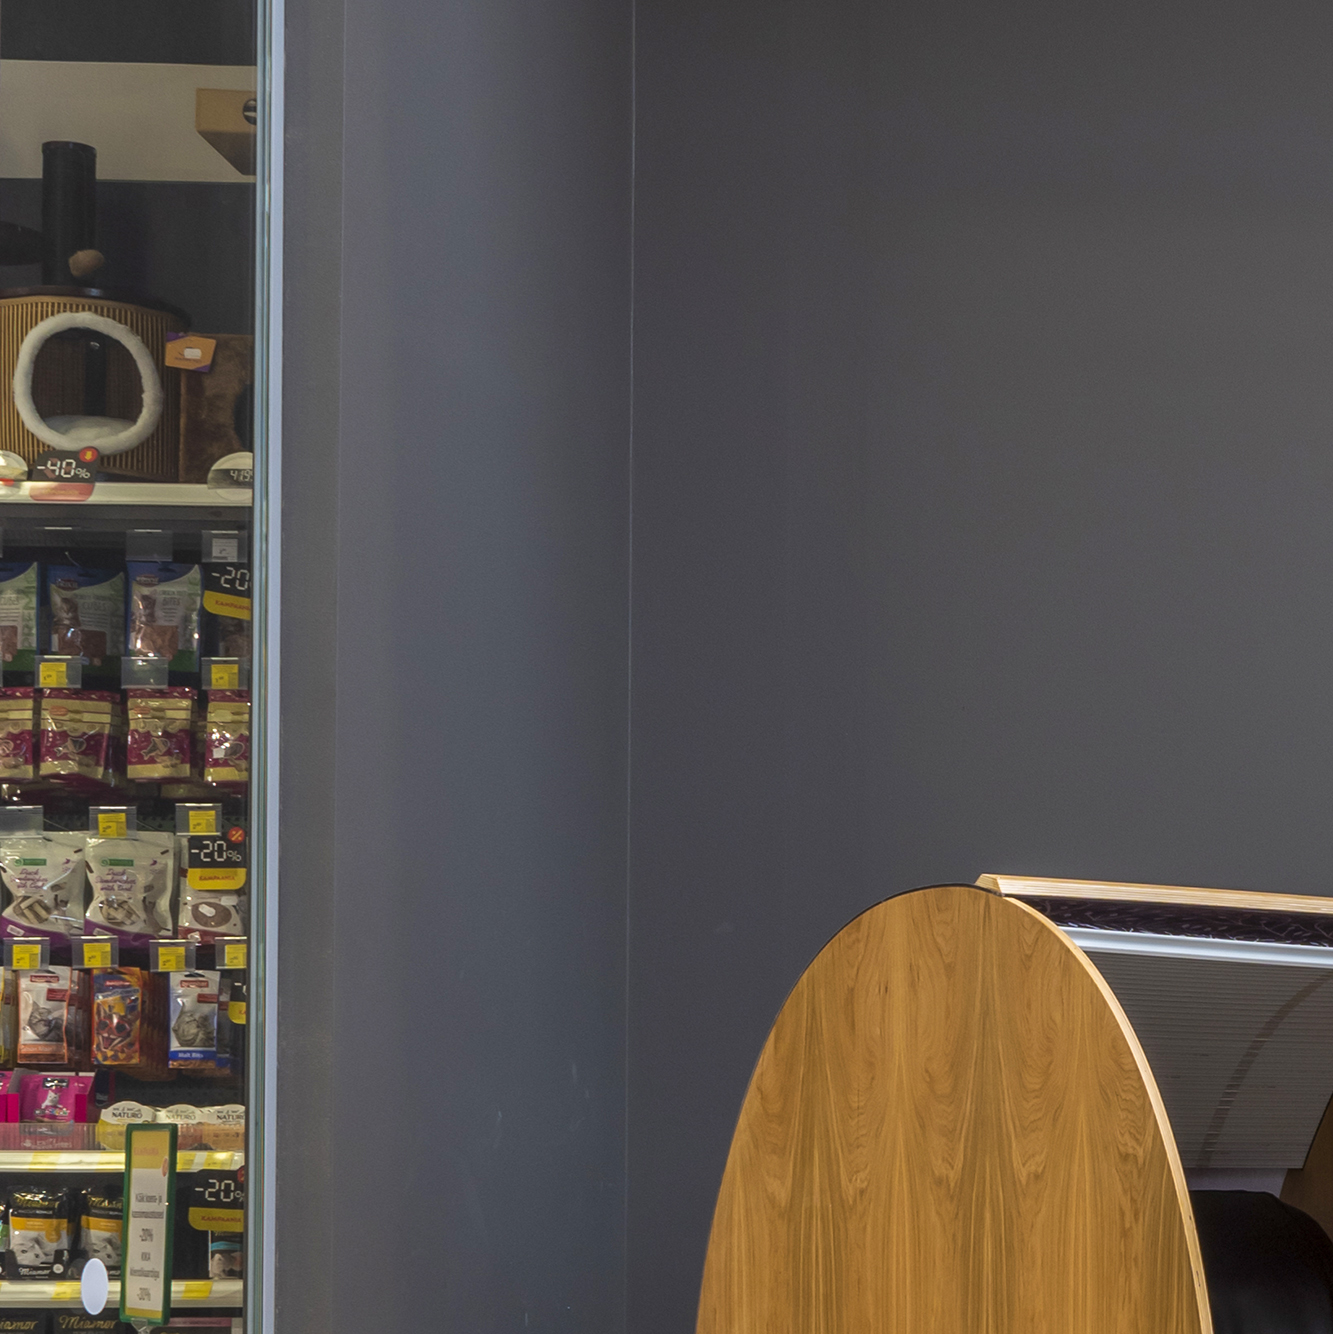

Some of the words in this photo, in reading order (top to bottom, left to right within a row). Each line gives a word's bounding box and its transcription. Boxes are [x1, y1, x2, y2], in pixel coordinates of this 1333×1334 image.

[37, 458, 91, 479] -40%
[211, 566, 250, 591] -20
[191, 840, 242, 862] -20%
[111, 1111, 143, 1119] NATURO
[216, 1113, 245, 1121] NATUR
[0, 1318, 39, 1331] iamor
[59, 1314, 118, 1330] Miamor
